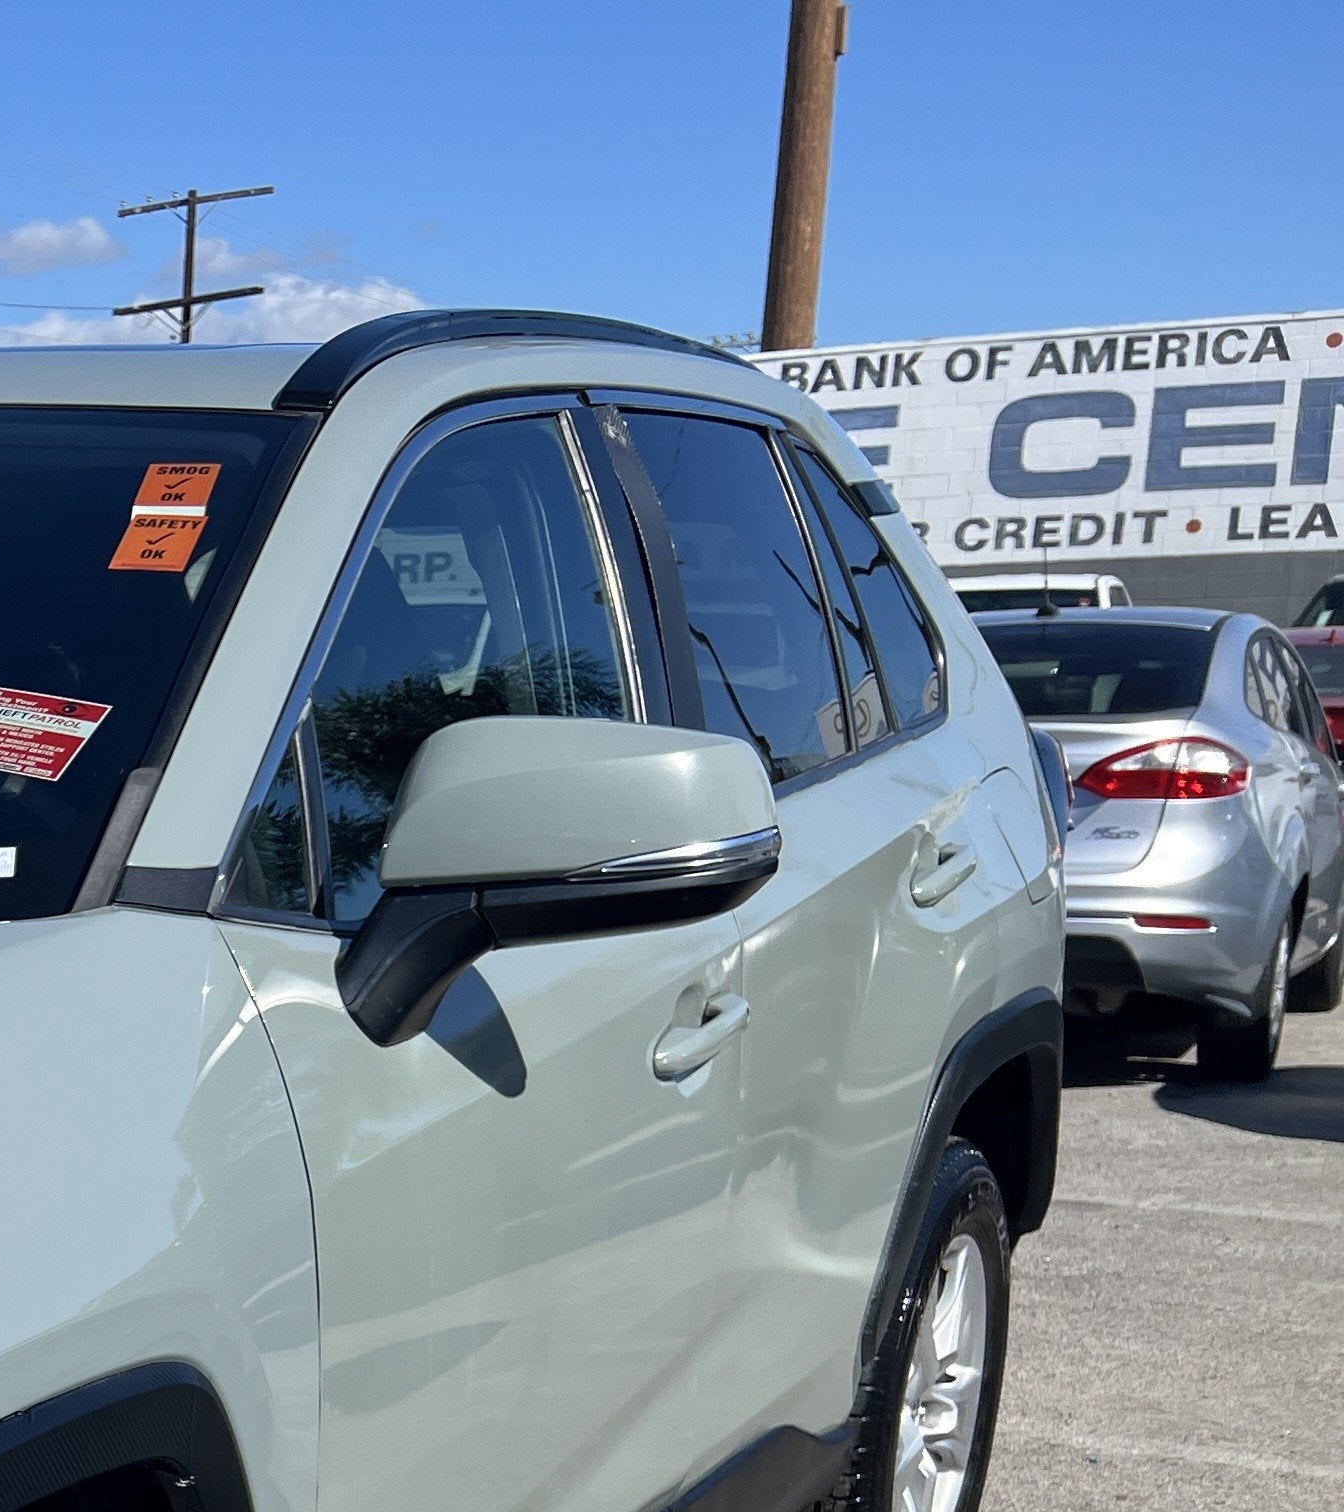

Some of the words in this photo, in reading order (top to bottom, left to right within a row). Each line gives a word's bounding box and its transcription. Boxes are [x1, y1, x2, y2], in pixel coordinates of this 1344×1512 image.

[781, 350, 924, 393] BANK
[945, 347, 1014, 382] OF
[1028, 326, 1291, 378] AMERICA
[156, 466, 211, 475] SMOG
[160, 492, 186, 502] OK
[134, 518, 202, 530] SAFETY
[955, 509, 1169, 552] CREDIT
[1227, 503, 1339, 540] LEA
[140, 549, 166, 559] OK
